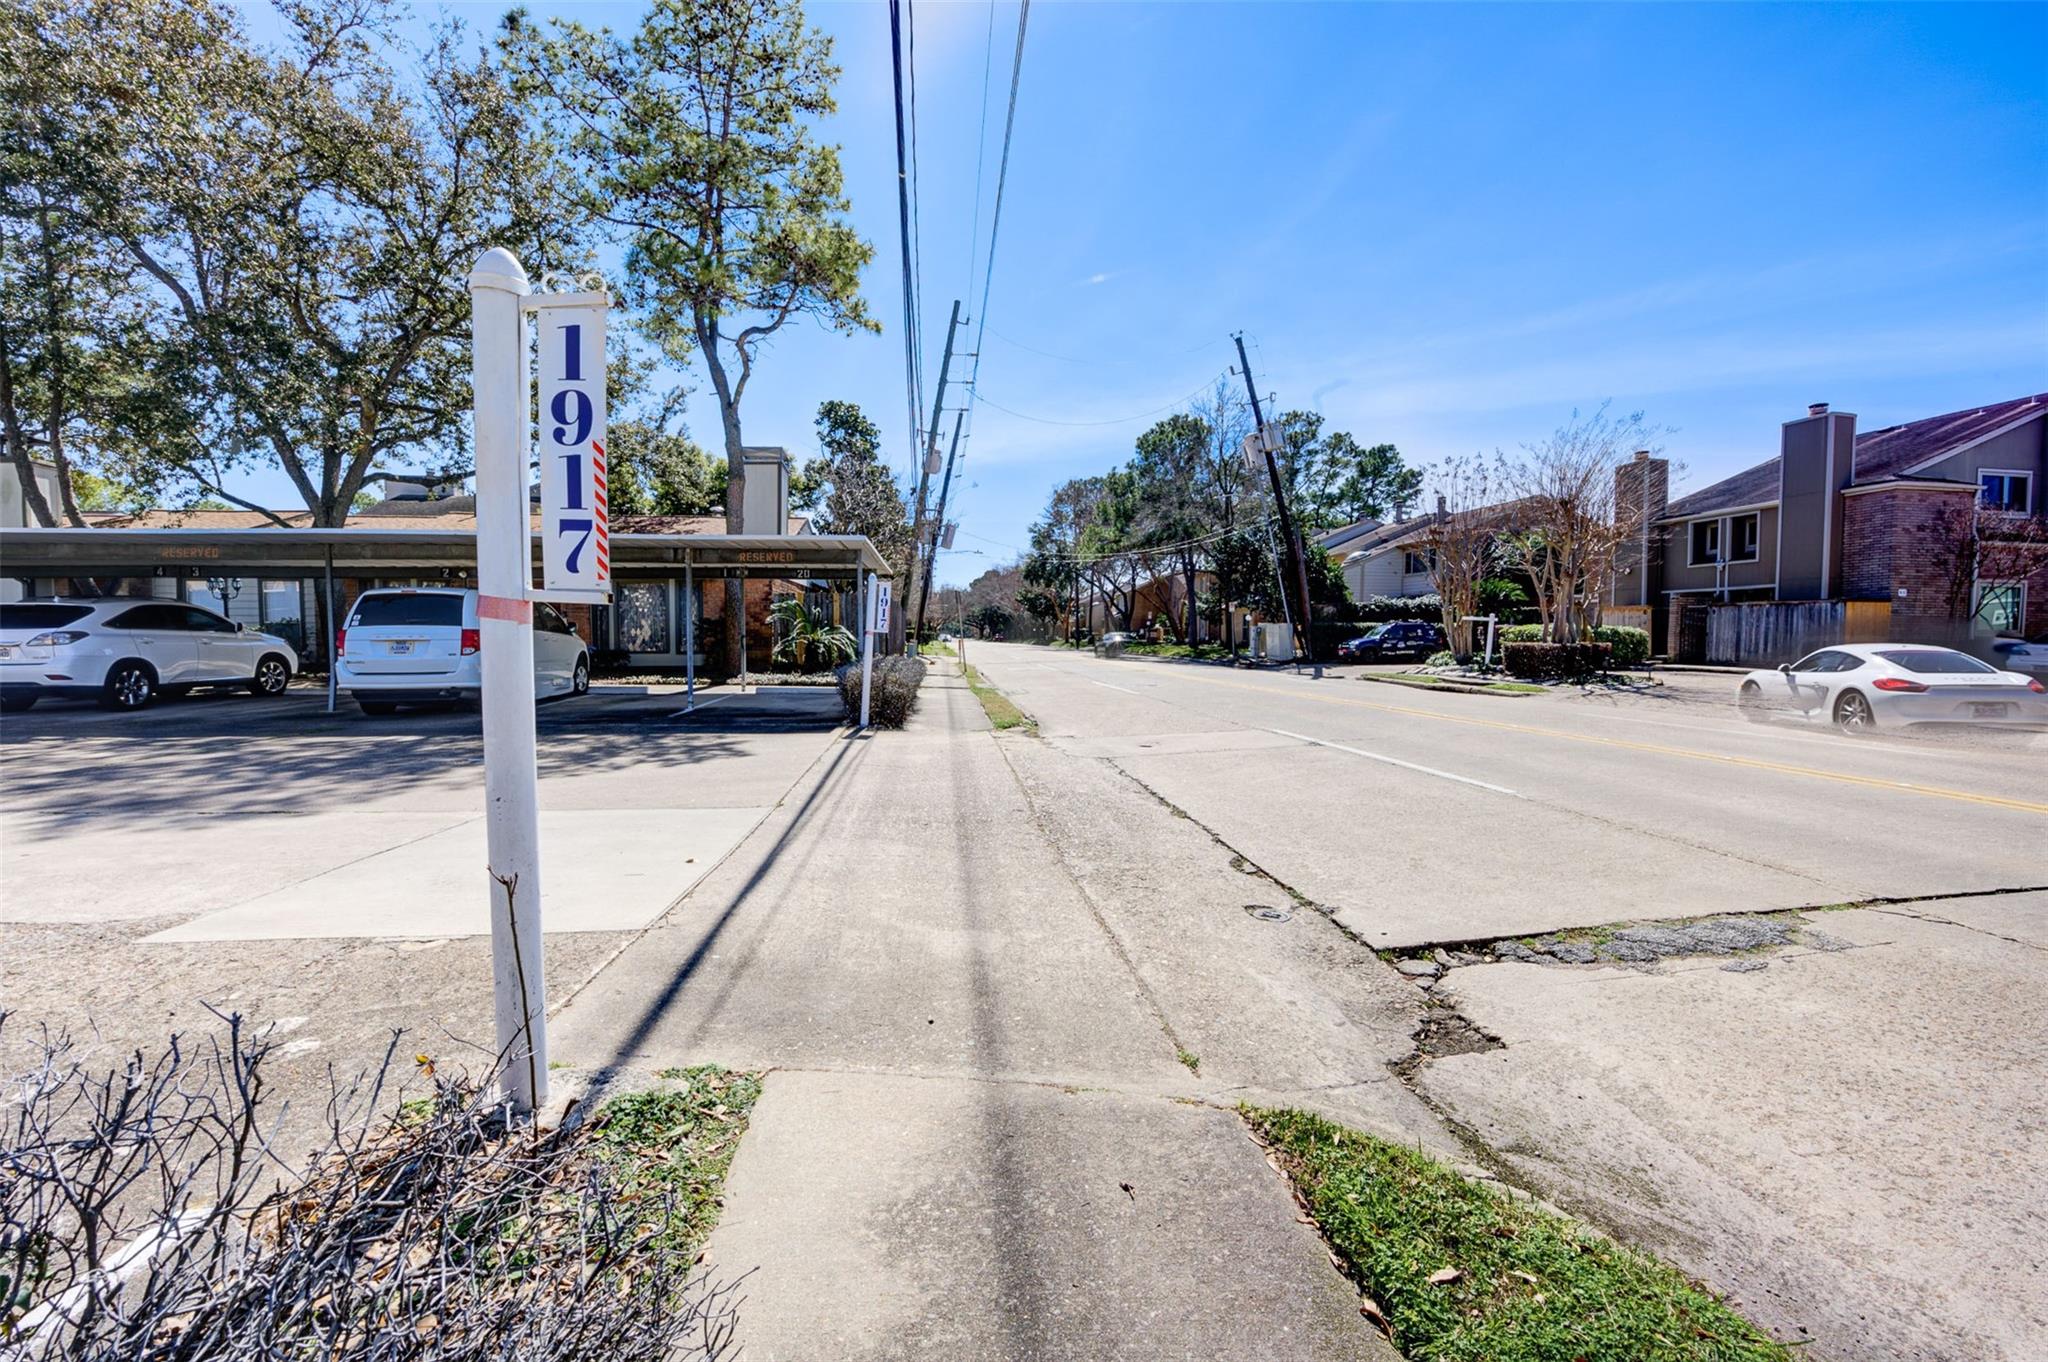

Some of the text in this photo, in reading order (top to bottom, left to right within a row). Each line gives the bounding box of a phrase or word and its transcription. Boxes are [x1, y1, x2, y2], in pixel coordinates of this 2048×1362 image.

[551, 325, 593, 574] 1917
[161, 547, 220, 558] RESERVED
[738, 552, 793, 562] RESERVED
[157, 567, 163, 576] 4
[192, 567, 199, 577] 3
[442, 568, 449, 578] 2
[797, 569, 810, 578] 20
[880, 587, 889, 629] 1917
